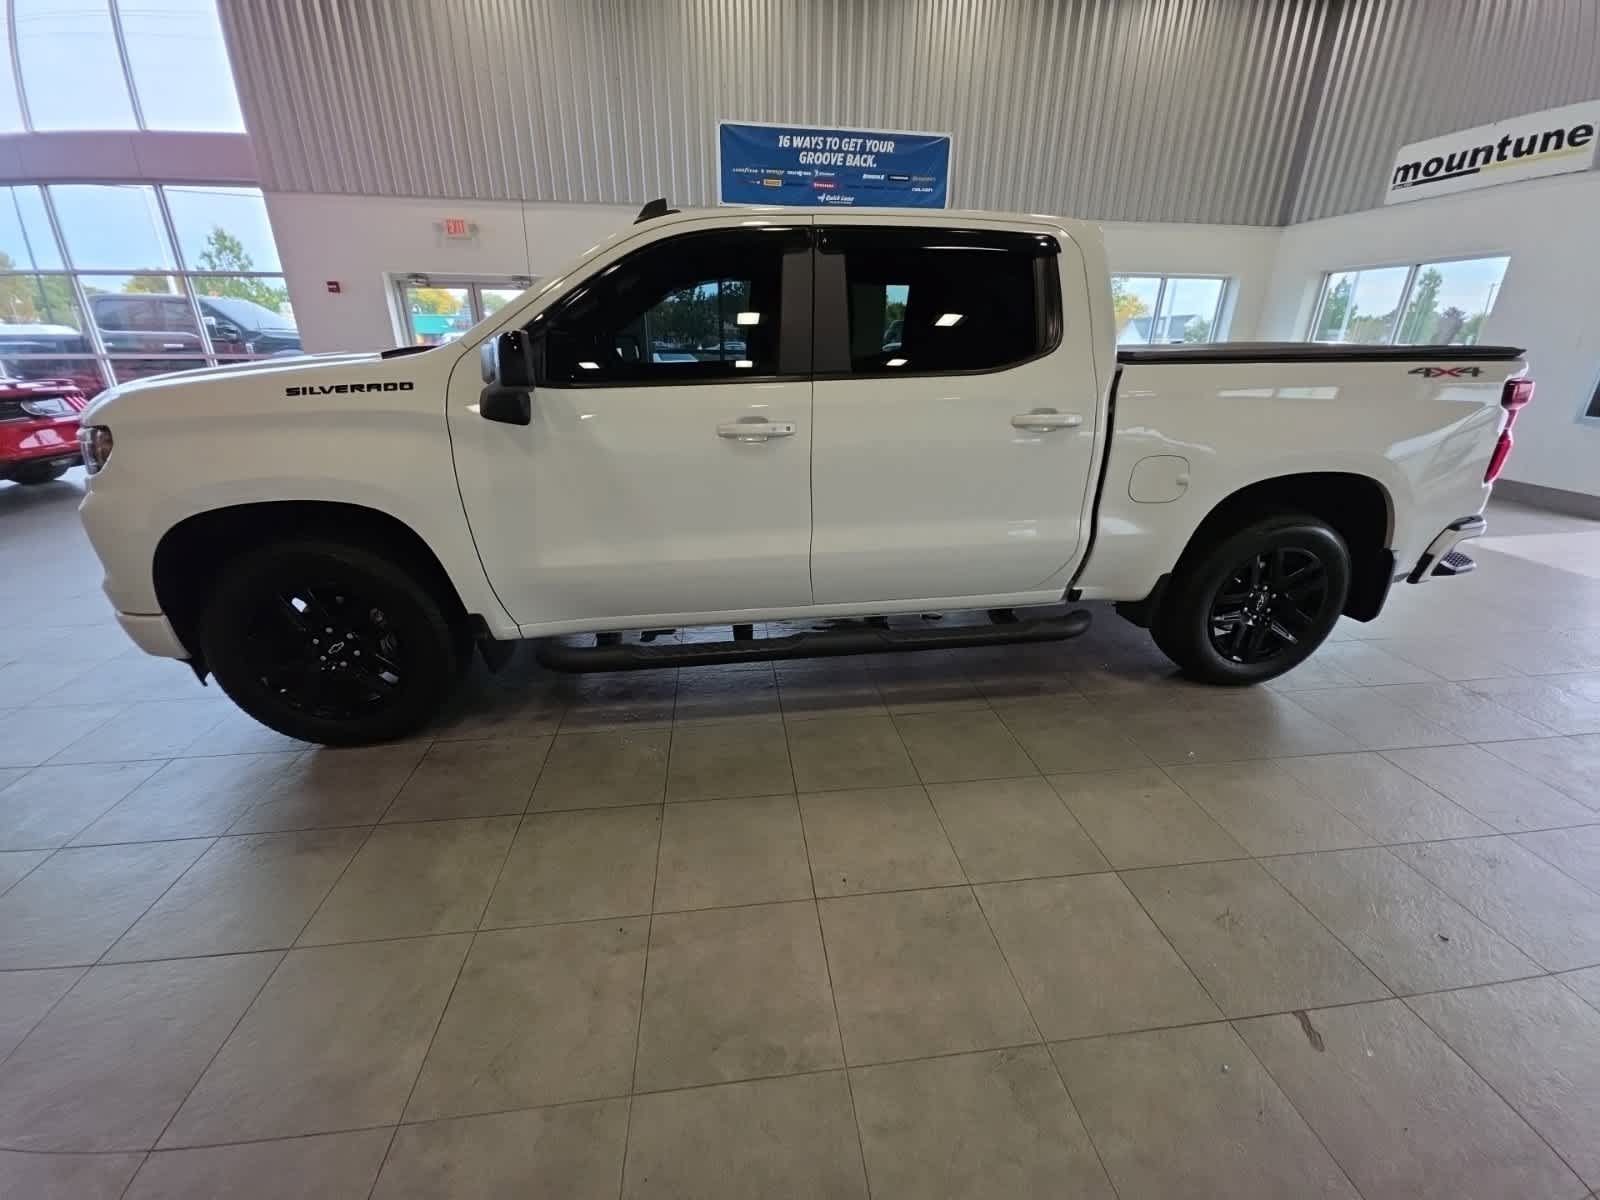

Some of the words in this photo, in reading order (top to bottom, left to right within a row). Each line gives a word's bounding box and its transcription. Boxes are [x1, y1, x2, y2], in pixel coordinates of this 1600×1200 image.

[778, 135, 791, 148] 16
[792, 135, 824, 150] WAYS
[825, 136, 840, 151] TO
[841, 137, 864, 152] GET
[865, 138, 895, 153] YOUR
[799, 151, 845, 166] GROOVE
[845, 153, 877, 168] BACK.
[1392, 123, 1594, 185] mountune
[285, 381, 414, 397] SILVERADO
